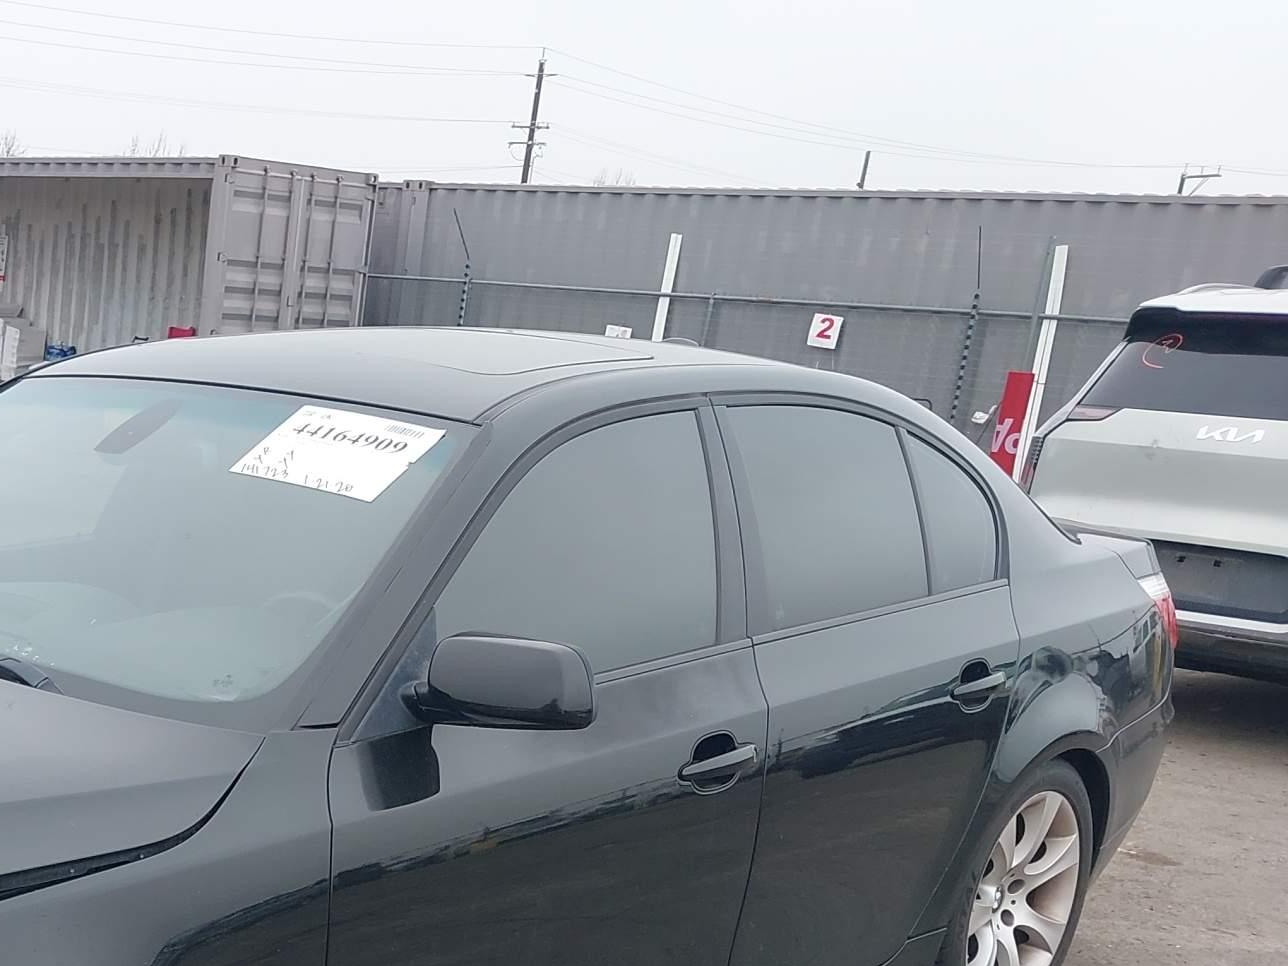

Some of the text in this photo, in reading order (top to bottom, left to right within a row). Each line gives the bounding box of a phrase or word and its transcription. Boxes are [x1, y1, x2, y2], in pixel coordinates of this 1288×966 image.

[816, 317, 835, 340] 2
[293, 423, 409, 455] 44164909
[1196, 425, 1265, 443] KIA
